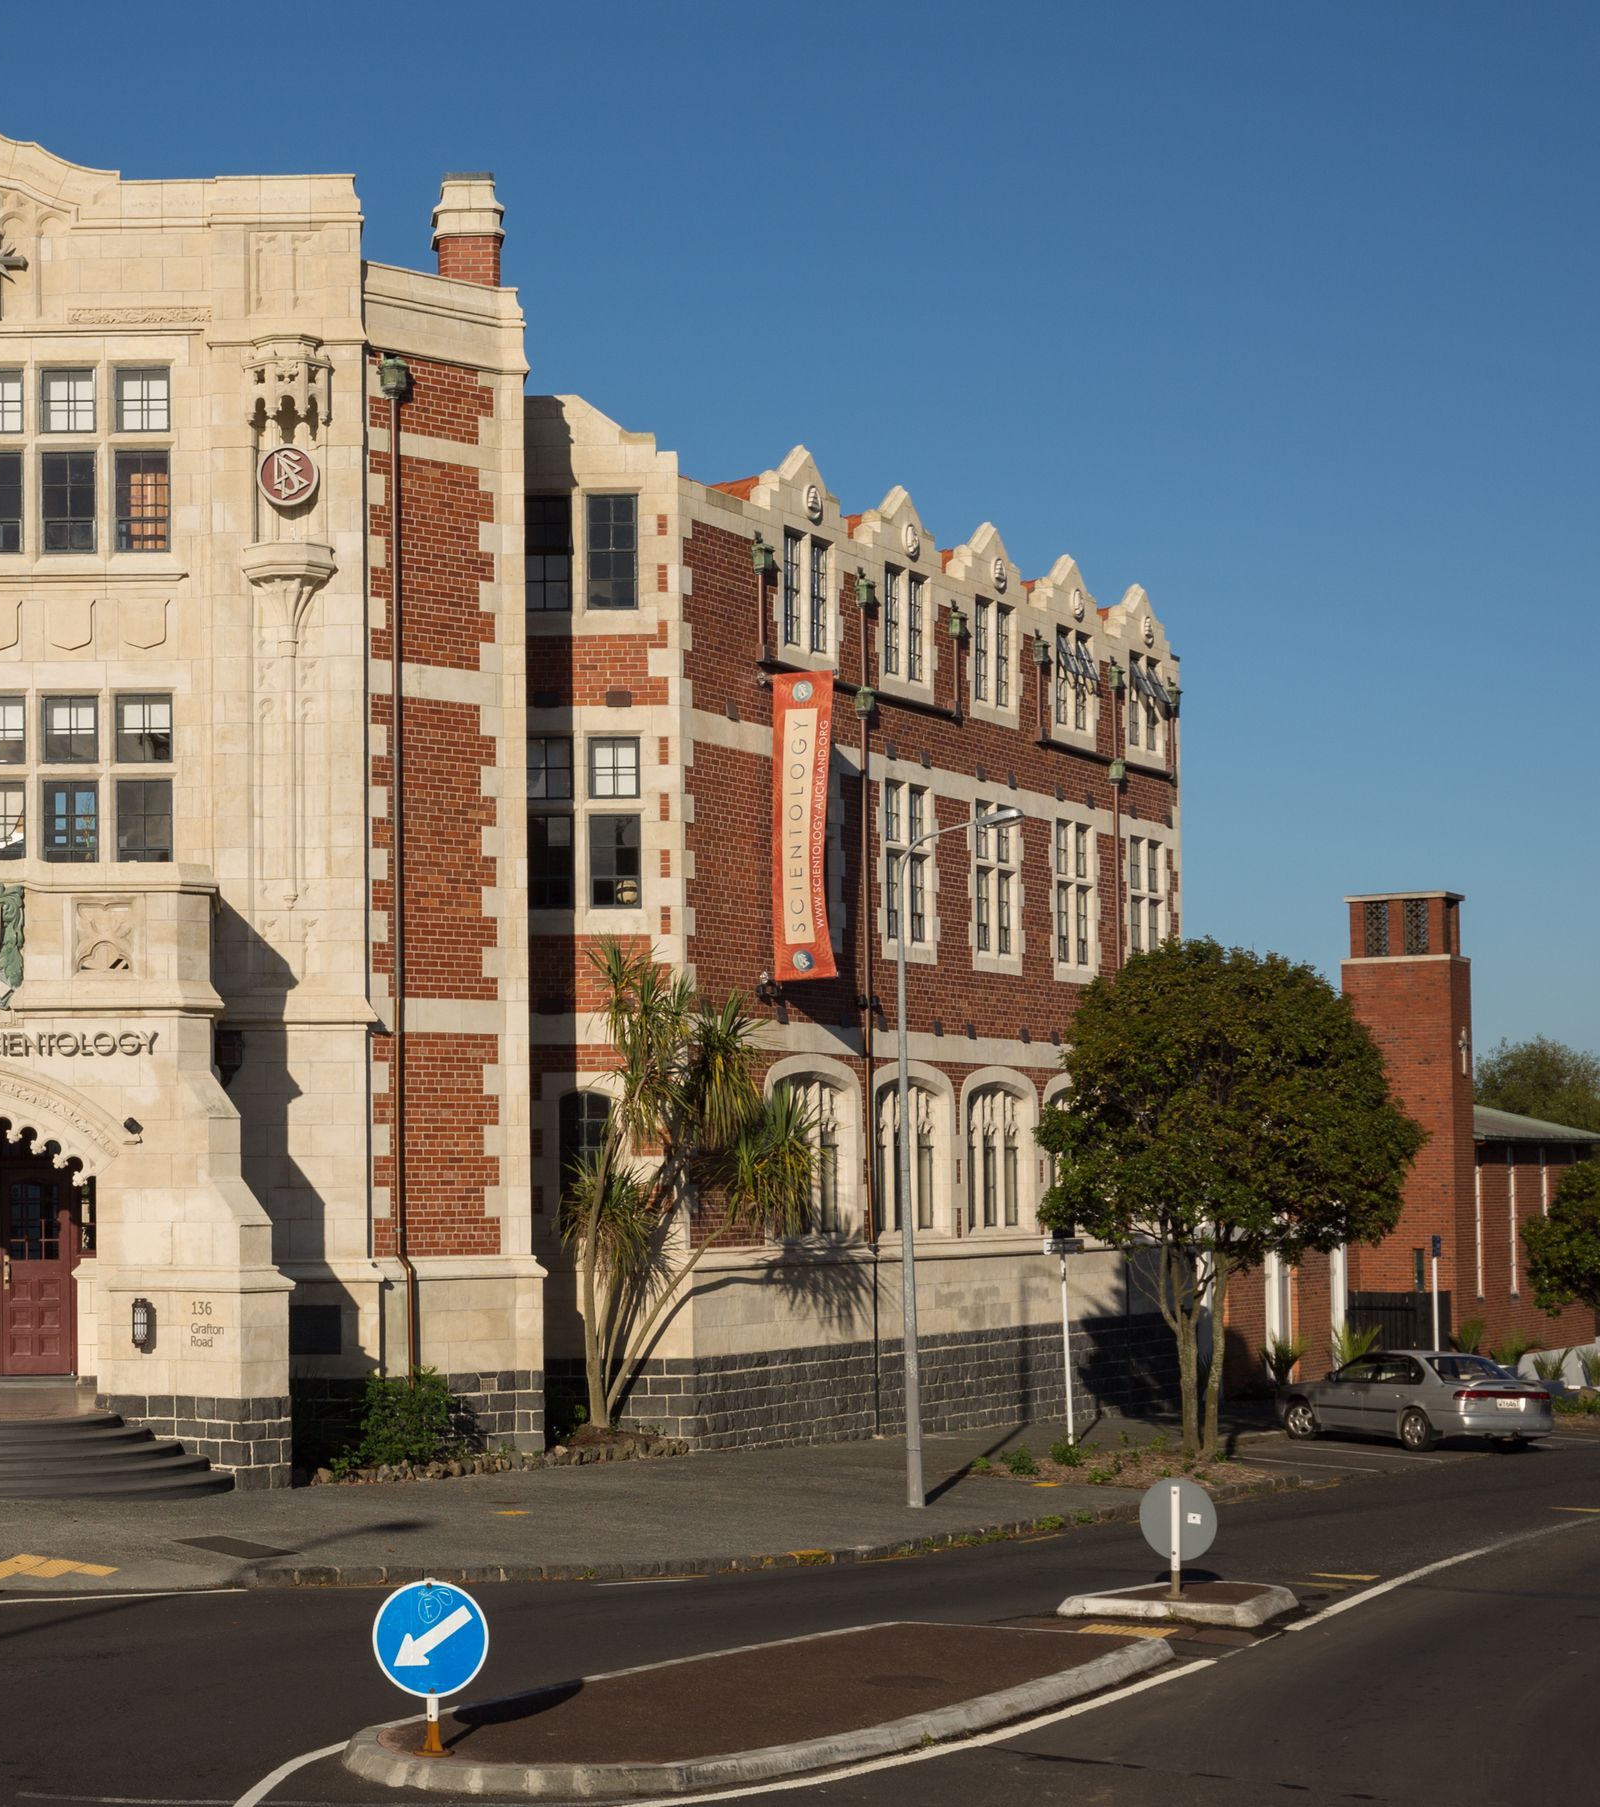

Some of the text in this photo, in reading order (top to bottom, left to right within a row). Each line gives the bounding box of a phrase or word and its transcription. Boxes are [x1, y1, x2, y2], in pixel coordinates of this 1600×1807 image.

[788, 720, 809, 933] SCIENTOLOGY
[812, 719, 829, 929] WWW.SCIENTOLOGY-AUCKLAND.ORG
[191, 1301, 213, 1316] 136
[190, 1322, 225, 1336] Grafton
[190, 1336, 214, 1348] Road
